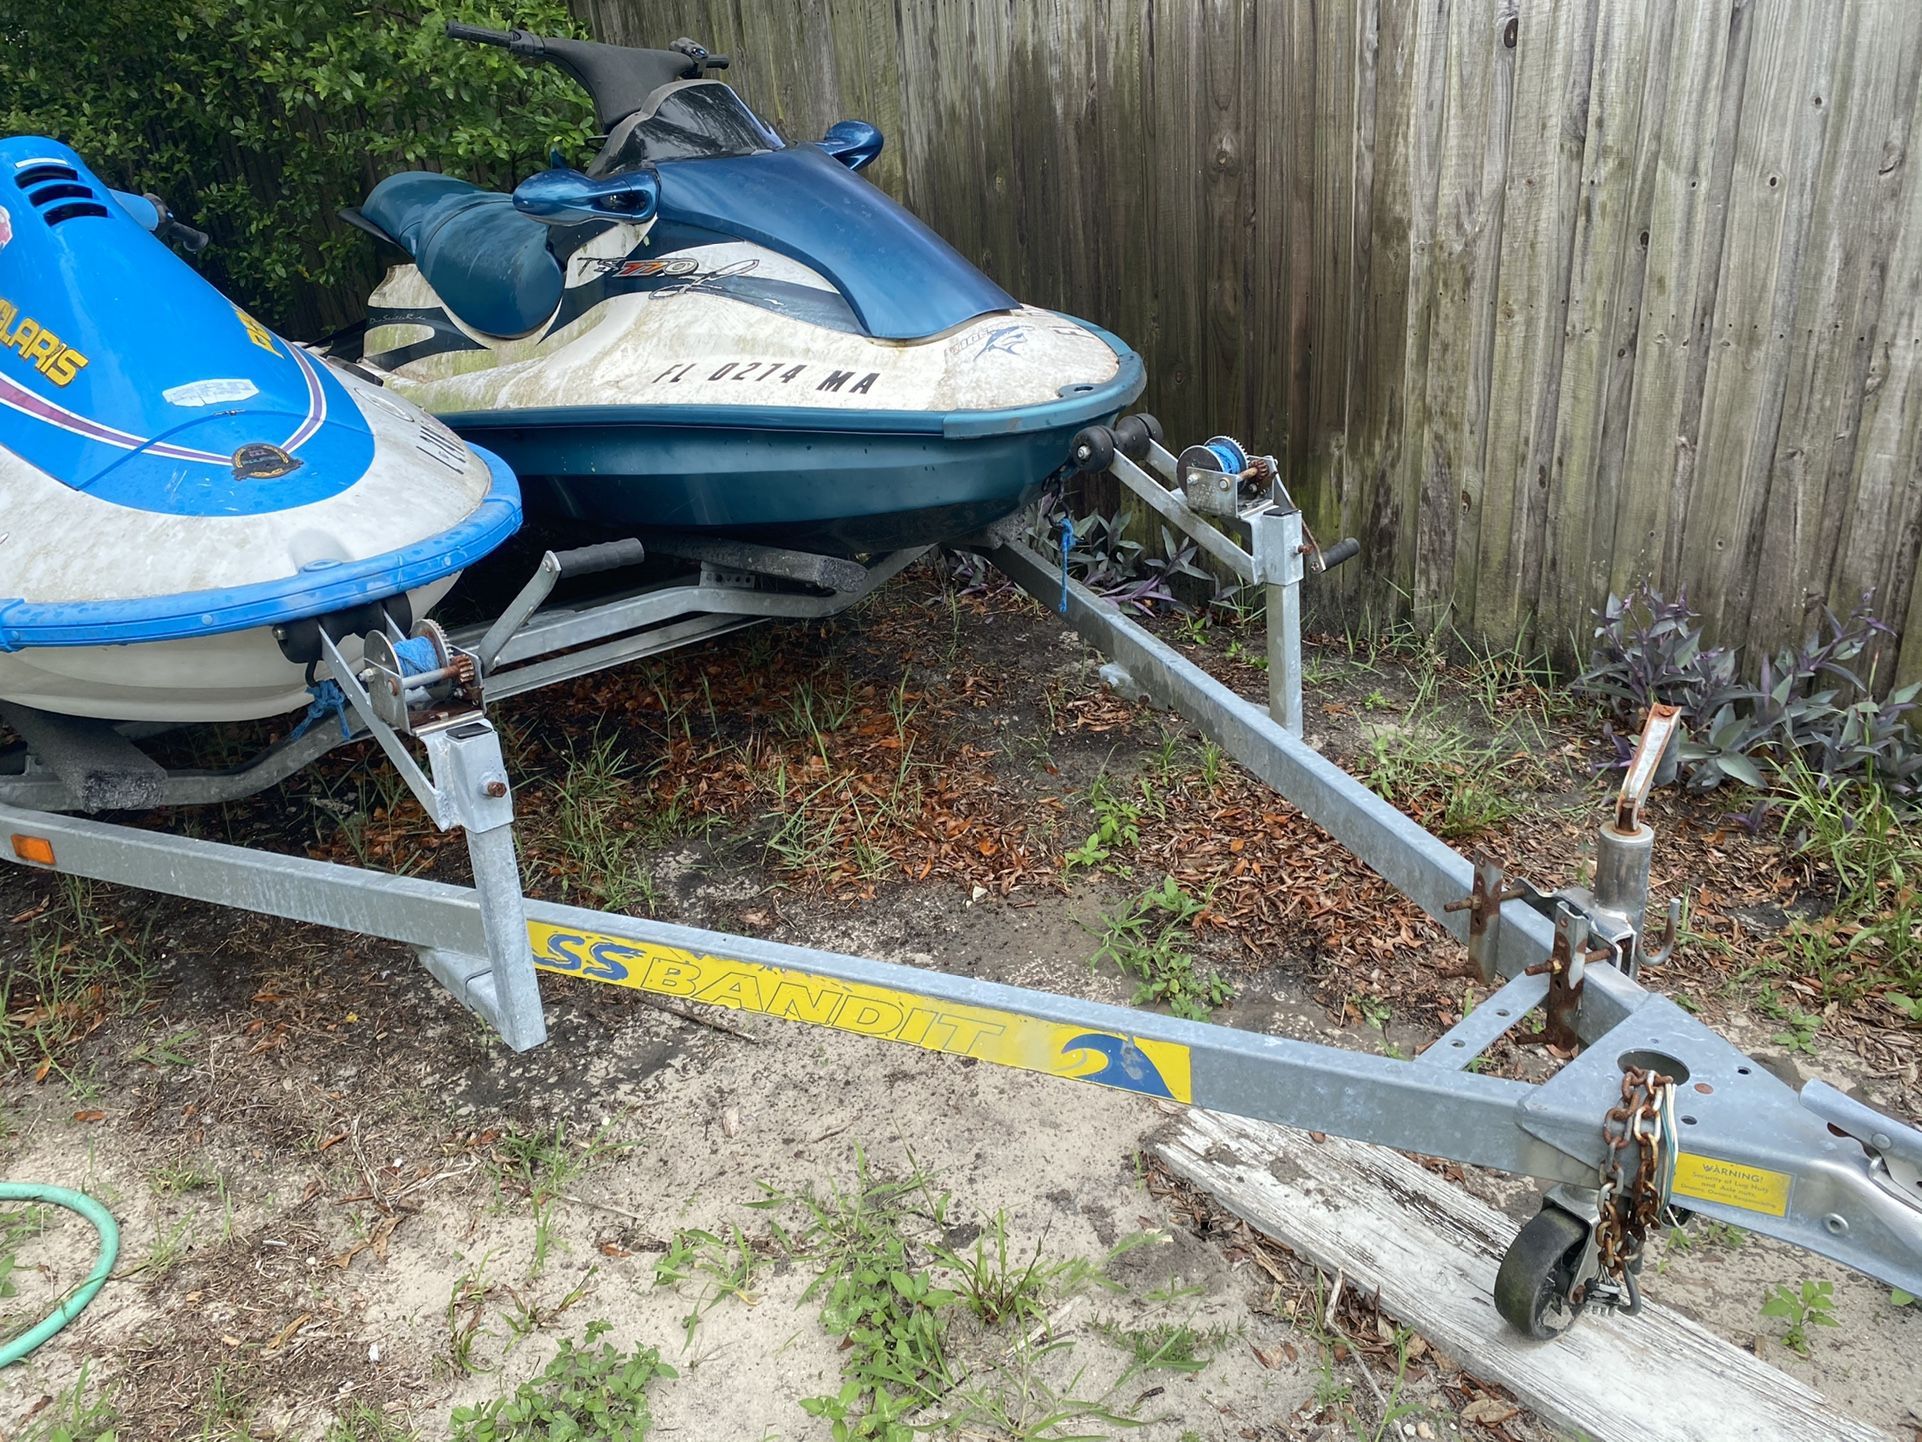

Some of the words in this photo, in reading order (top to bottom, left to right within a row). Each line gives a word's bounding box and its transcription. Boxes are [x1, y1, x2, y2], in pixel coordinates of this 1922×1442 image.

[652, 363, 697, 384] FL
[708, 362, 808, 384] 0274
[815, 370, 880, 395] MA
[640, 957, 1005, 1056] BANDIT
[1703, 1163, 1763, 1183] WARNING!
